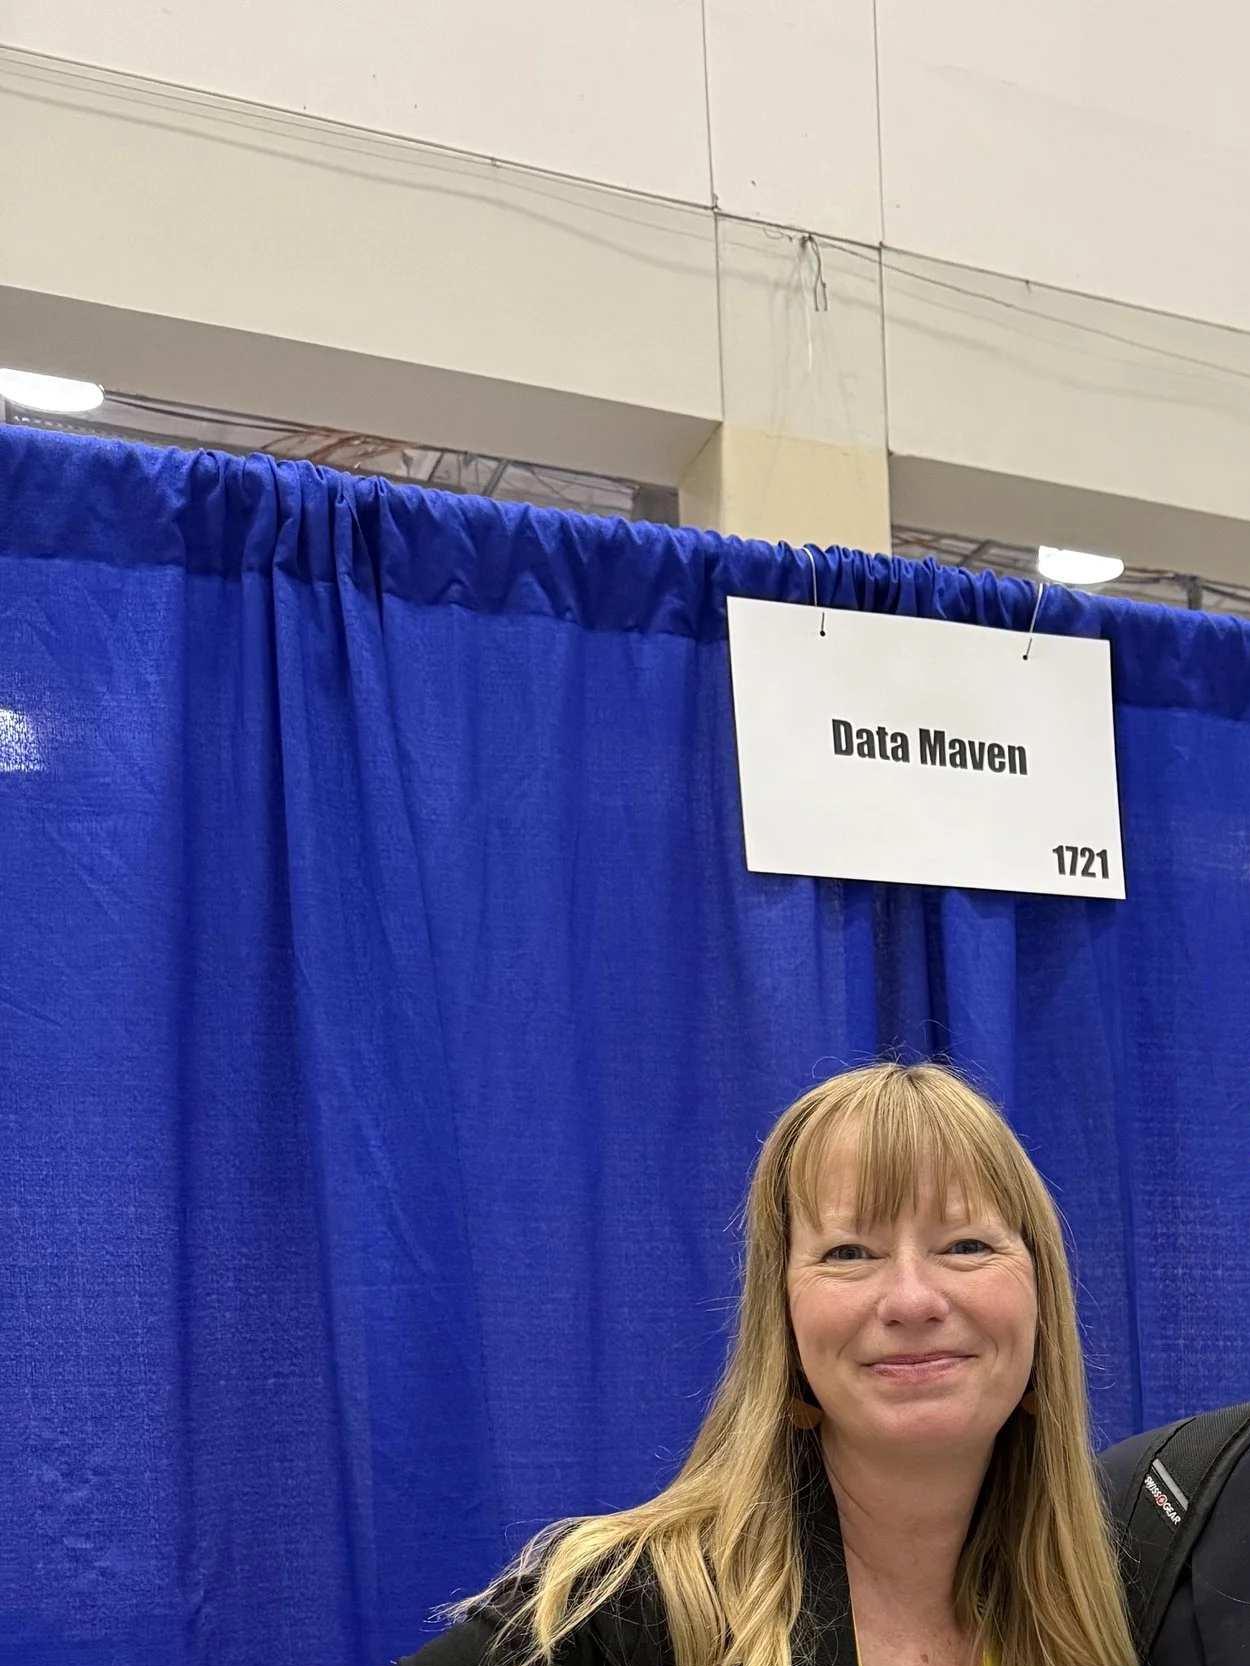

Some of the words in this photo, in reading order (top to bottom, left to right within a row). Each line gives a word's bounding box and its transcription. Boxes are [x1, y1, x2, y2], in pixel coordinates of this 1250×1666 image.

[832, 719, 910, 763] Data
[919, 728, 1028, 775] Maven
[1052, 845, 1110, 879] 1721
